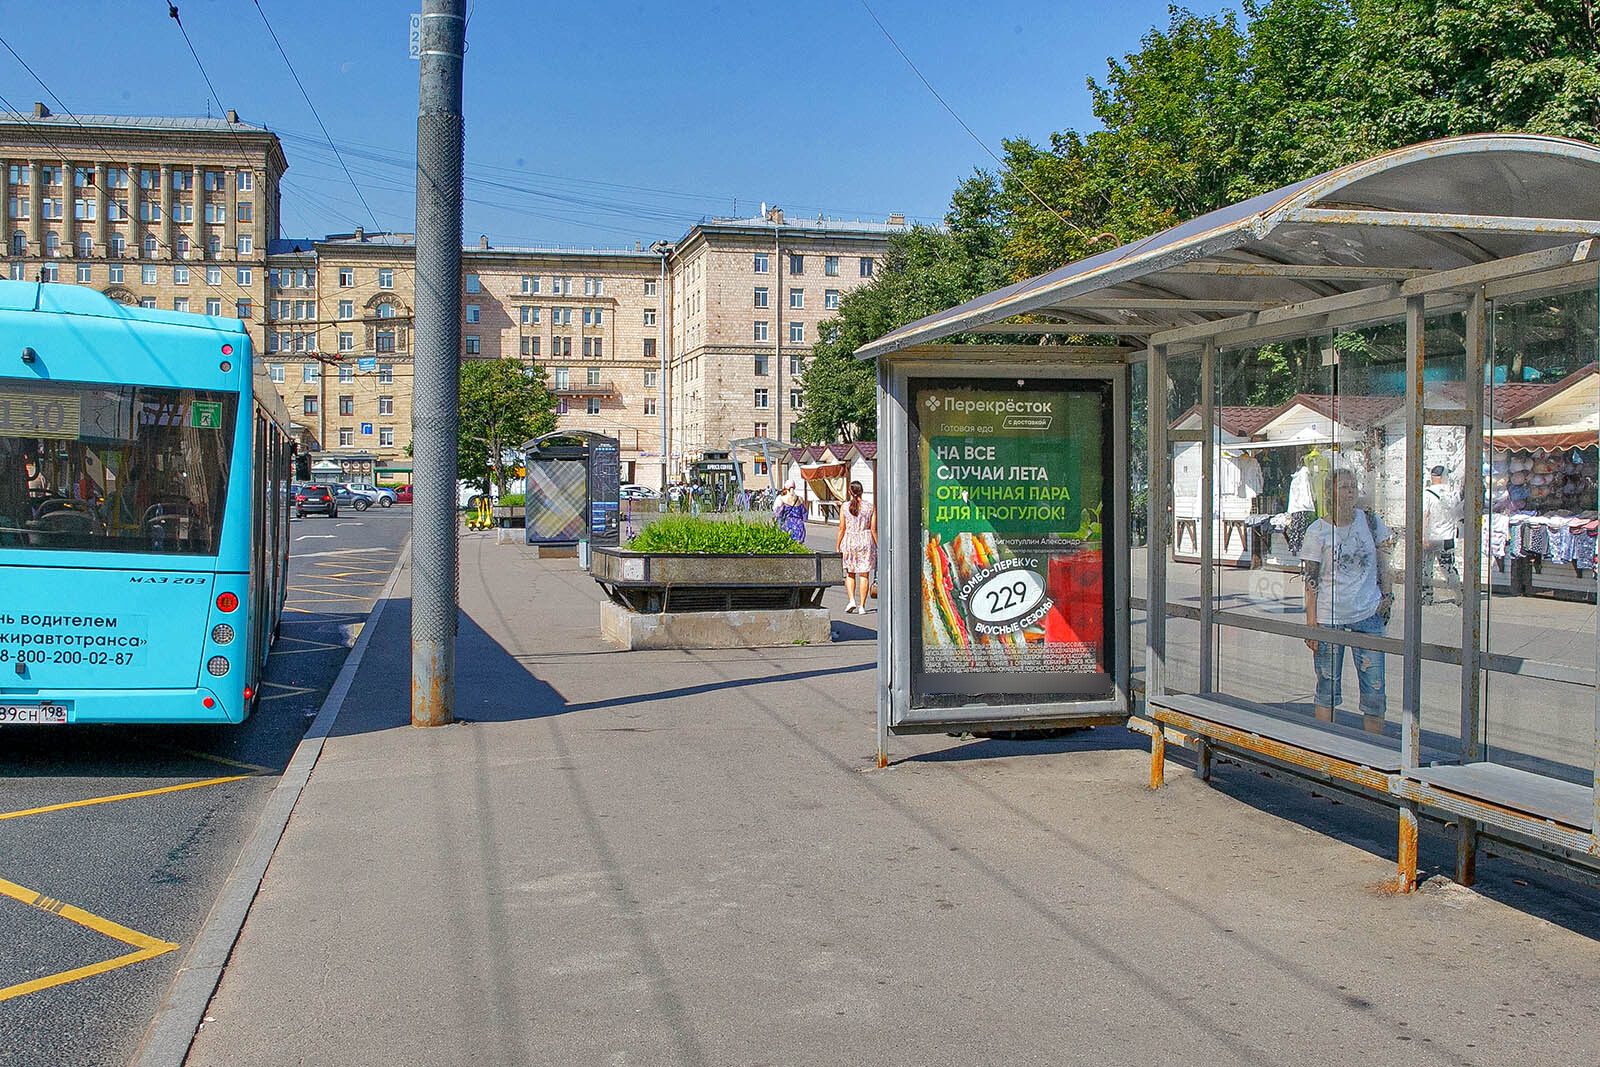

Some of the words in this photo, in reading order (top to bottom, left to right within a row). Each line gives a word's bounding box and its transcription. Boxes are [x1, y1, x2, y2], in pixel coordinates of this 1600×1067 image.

[411, 17, 420, 56] 022
[944, 396, 1052, 415] Перекрёсток
[940, 424, 975, 433] Готовая
[976, 425, 994, 434] еда
[1013, 418, 1047, 426] доставкой
[936, 446, 960, 460] НА
[964, 446, 996, 460] ВСЕ
[936, 465, 1004, 481] СЛУЧАИ
[1008, 466, 1048, 481] ЛЕТА
[1029, 487, 1070, 501] ПАРА
[935, 506, 971, 522] ДЛЯ
[975, 506, 1065, 521] ПРОГУЛОК!
[1040, 537, 1081, 546] Александр
[128, 576, 169, 584] МАЗ
[172, 576, 207, 585] 203
[958, 557, 1039, 601] КОМБО-ПЕРЕКУС
[985, 581, 1027, 615] 229
[20, 614, 118, 628] водителем
[974, 622, 1020, 636] ВКУСНЫЕ
[1019, 597, 1055, 628] СЕЗОНЫ
[0, 649, 134, 666] 8-800-200-02-87
[41, 706, 63, 718] 198
